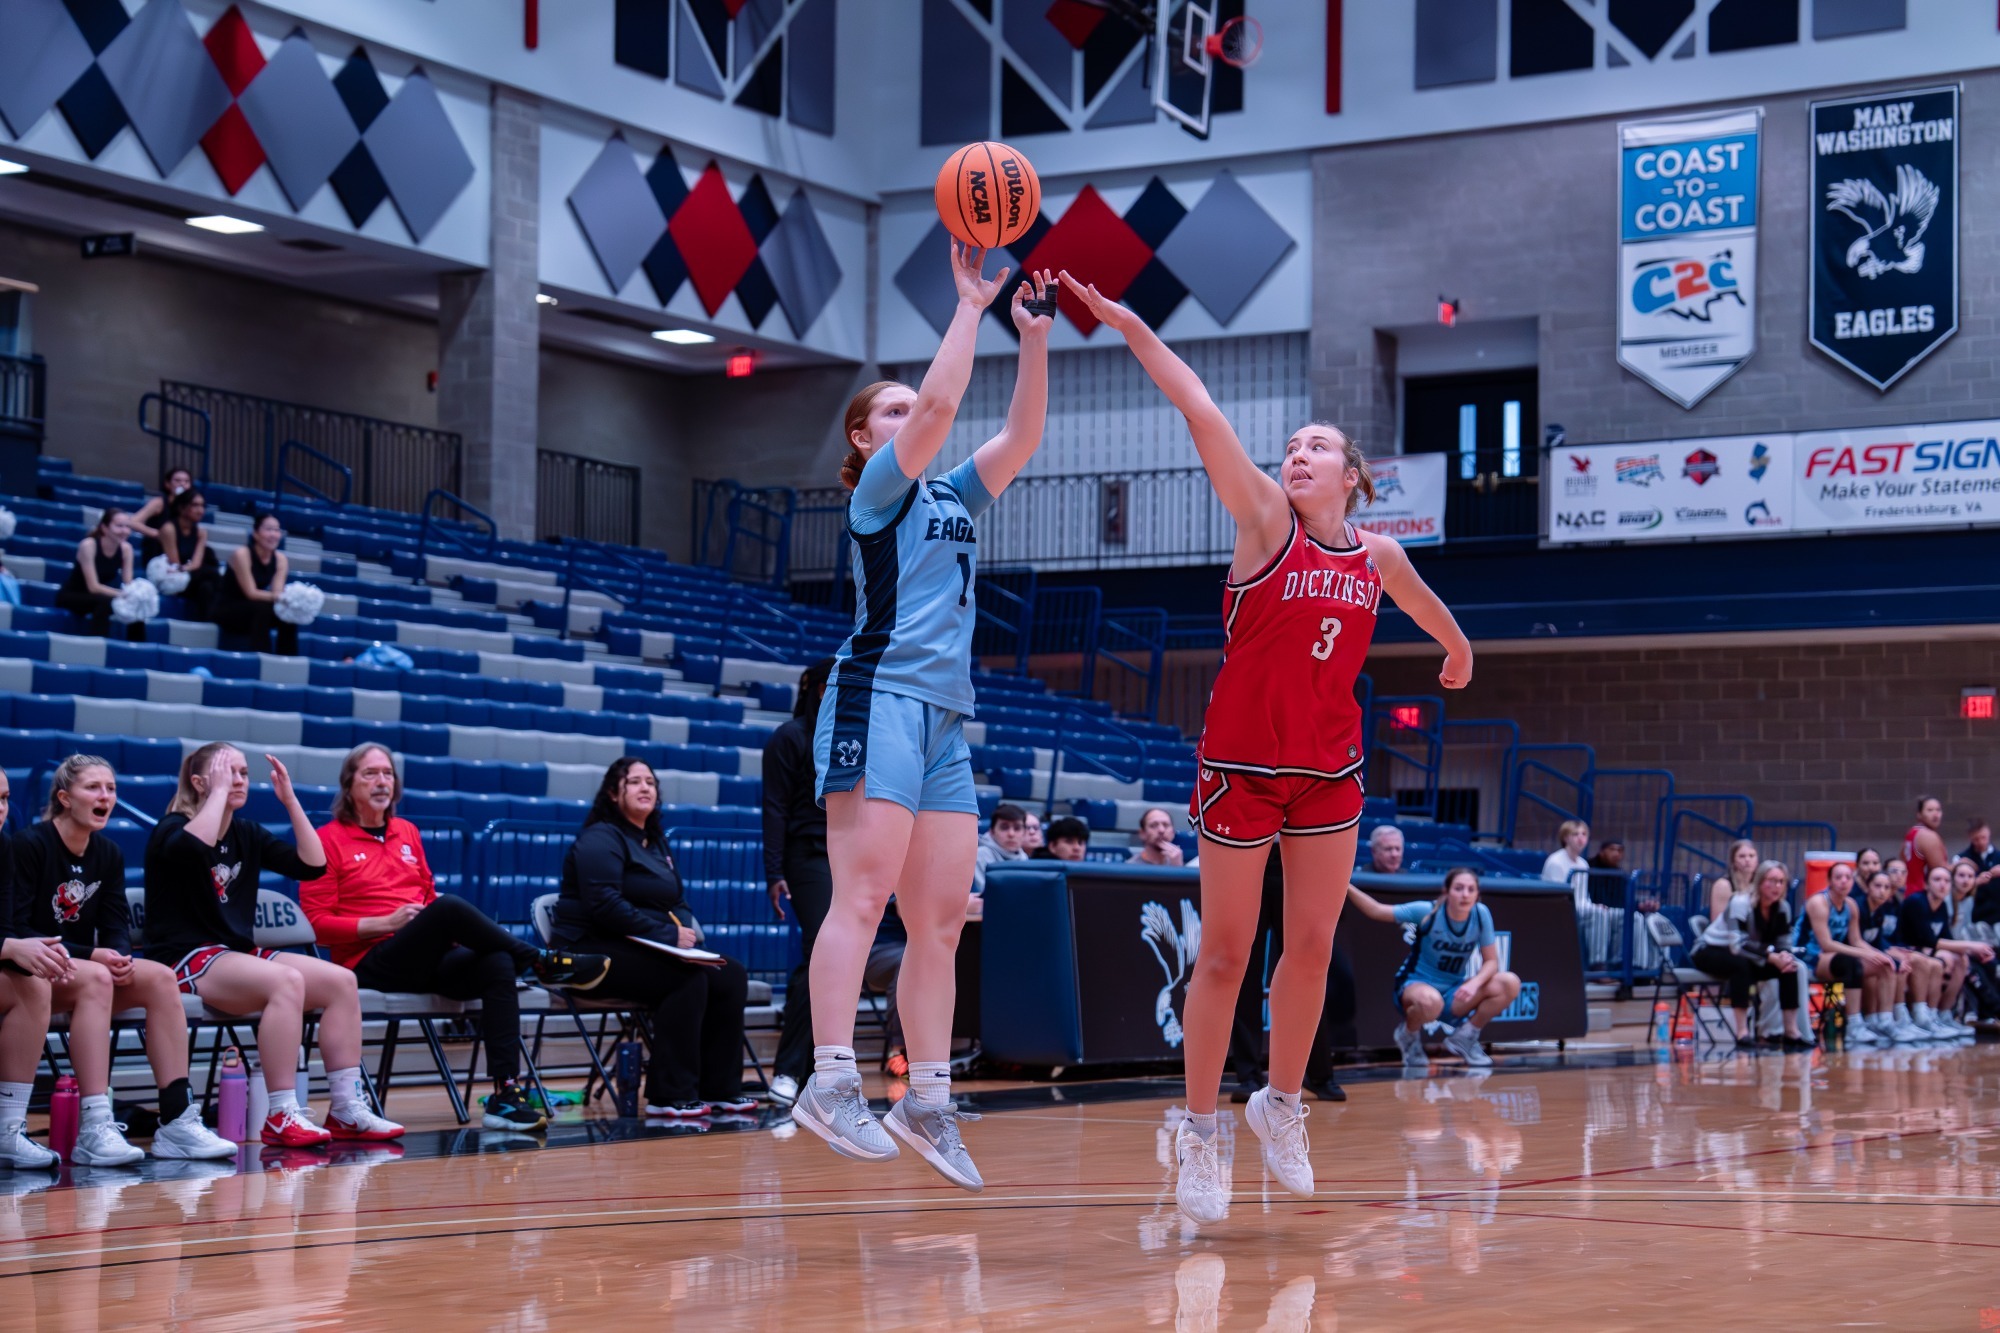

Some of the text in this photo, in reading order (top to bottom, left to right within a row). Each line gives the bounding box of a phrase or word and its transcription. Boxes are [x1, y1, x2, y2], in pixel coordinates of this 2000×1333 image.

[1853, 102, 1915, 130] MARY
[1816, 118, 1953, 155] WASHINGTON
[1635, 142, 1745, 180] COAST
[970, 170, 992, 224] NCAA
[1001, 158, 1024, 230] Wilson
[1635, 195, 1745, 231] COAST
[1632, 261, 1737, 314] C2C
[1834, 304, 1935, 339] EAGLES
[1659, 343, 1719, 359] MEMBER
[1820, 483, 1870, 500] Make
[1875, 480, 1917, 497] Your
[1965, 501, 1982, 513] VA
[1556, 510, 1606, 528] NAC
[1311, 617, 1342, 661] 3
[1968, 696, 1992, 718] EXIT
